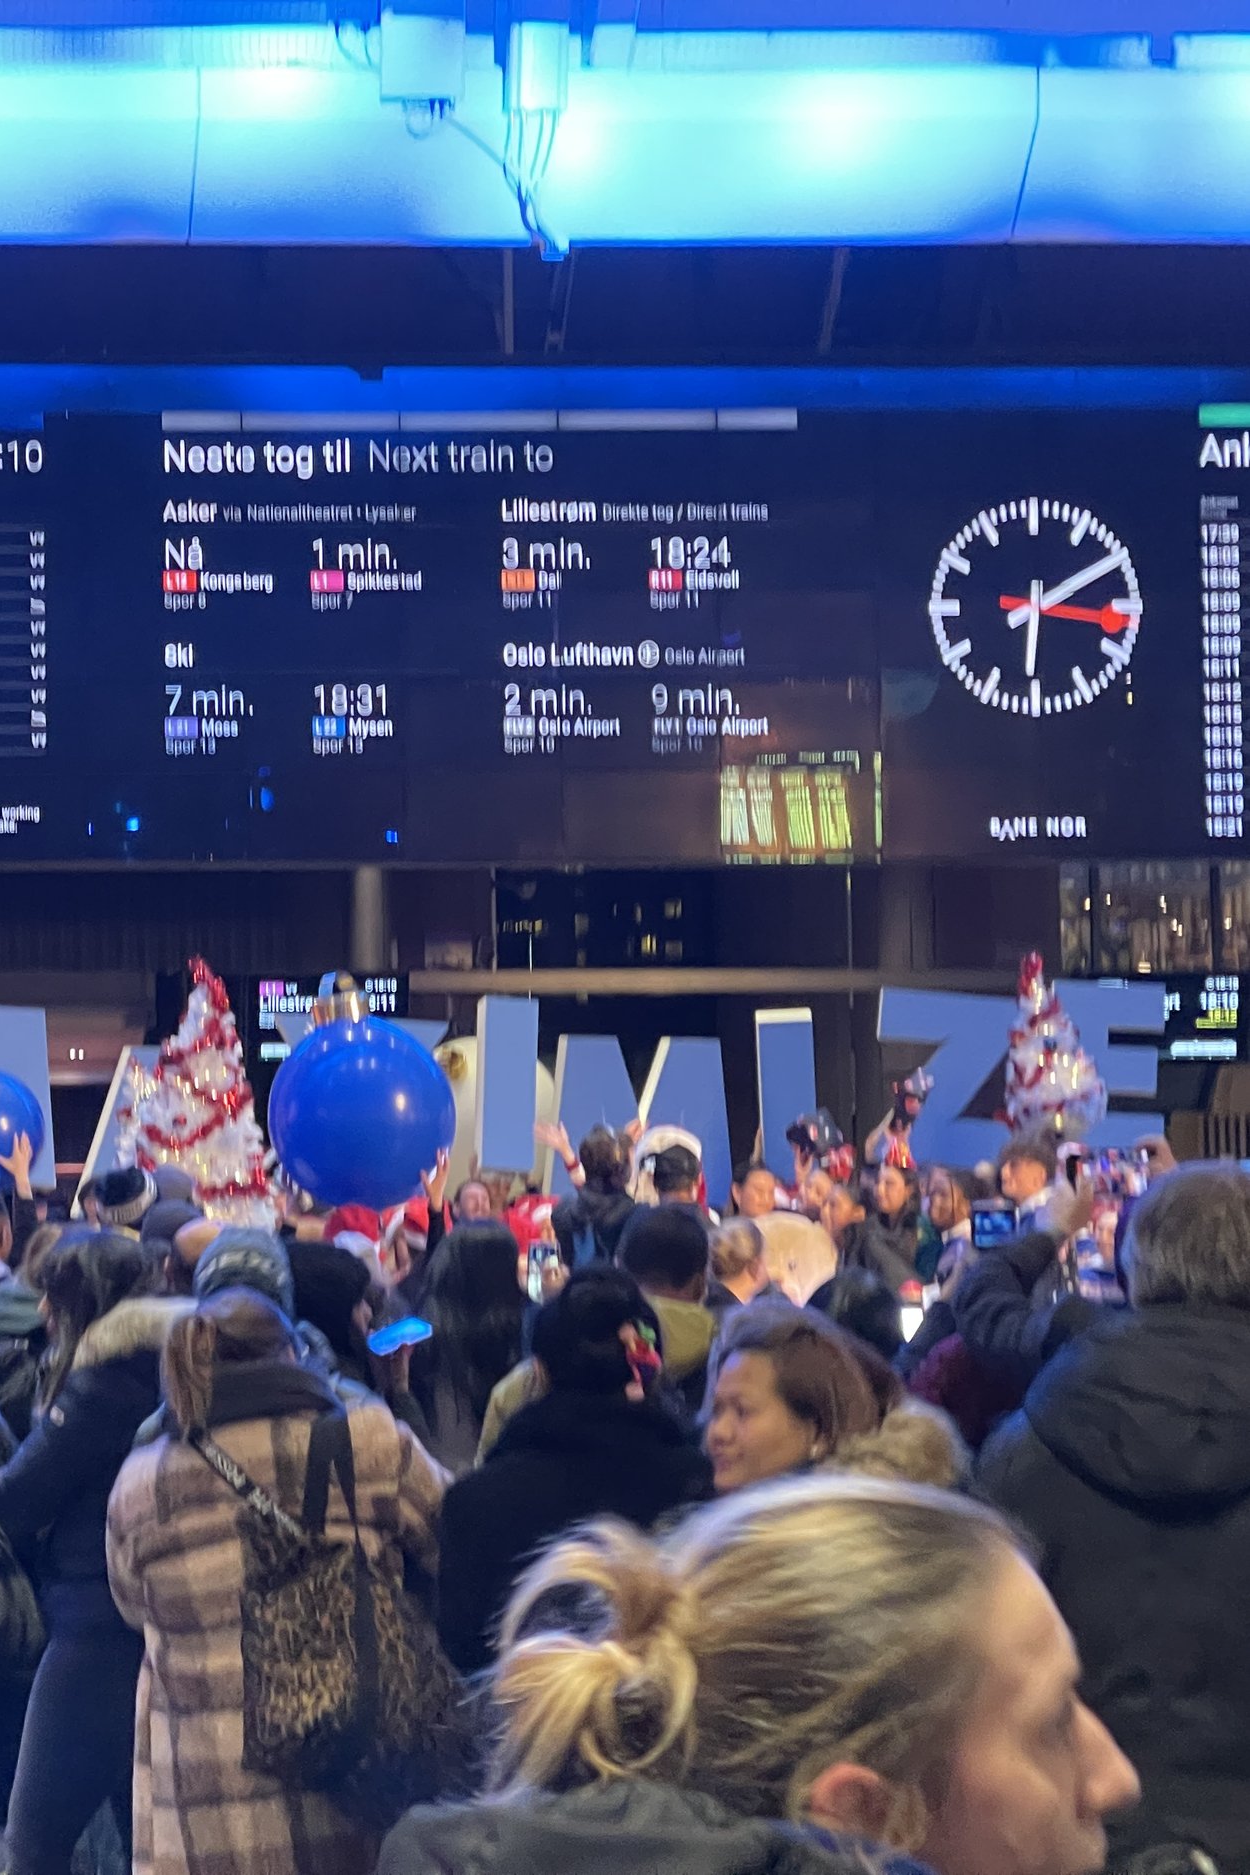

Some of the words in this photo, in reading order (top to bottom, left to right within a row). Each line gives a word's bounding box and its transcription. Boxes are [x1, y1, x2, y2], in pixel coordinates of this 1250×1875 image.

[263, 440, 314, 480] tog
[323, 437, 350, 473] til
[369, 438, 439, 473] Next
[447, 438, 514, 473] train
[523, 440, 553, 473] to
[163, 498, 217, 523] Asker
[502, 497, 596, 523] Lillestrøm
[165, 536, 203, 570] Nå
[312, 537, 324, 570] 1
[338, 537, 398, 570] min.
[502, 537, 519, 570] 3
[529, 536, 591, 570] min.
[651, 536, 732, 570] 18:24
[200, 571, 273, 594] Kongsberg
[503, 642, 546, 668] Oslo
[550, 641, 634, 668] Lufthavn
[165, 684, 182, 716] 7
[192, 684, 254, 717] min.
[314, 683, 387, 717] 18:31
[504, 683, 521, 716] 2
[530, 683, 592, 716] min.
[651, 683, 669, 715] 9
[678, 683, 740, 715] min.
[989, 816, 1038, 841] BANE
[1046, 816, 1087, 838] NOR
